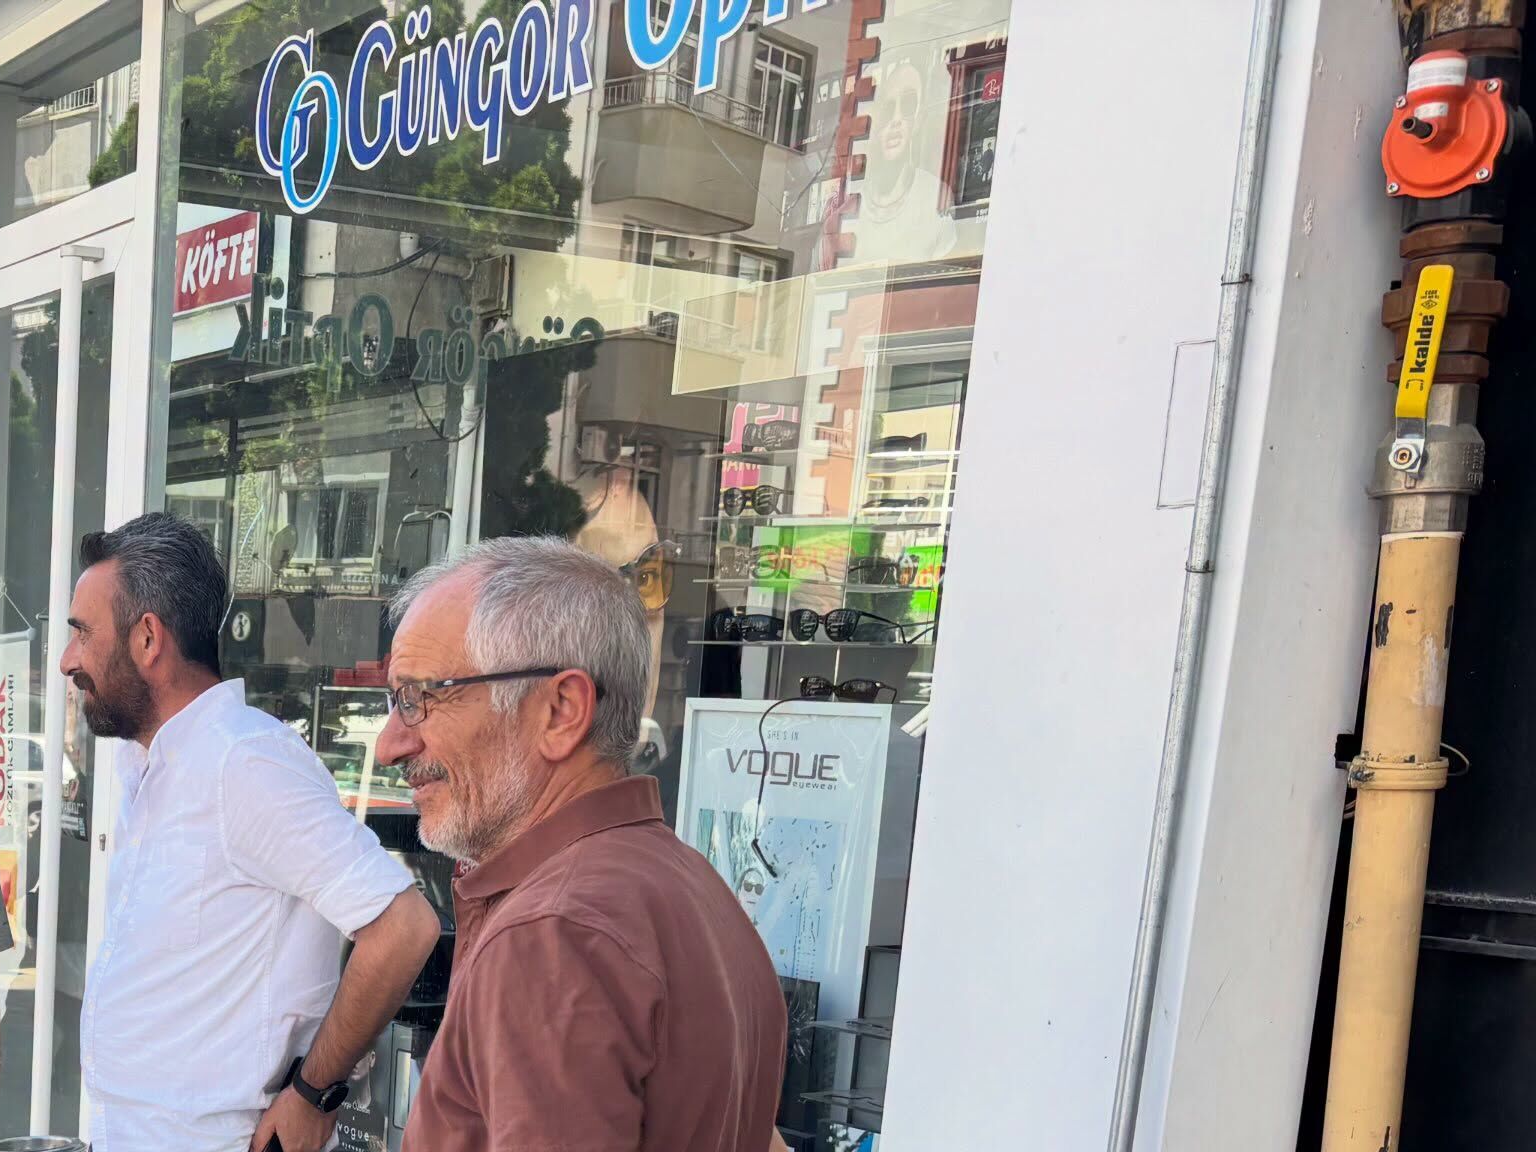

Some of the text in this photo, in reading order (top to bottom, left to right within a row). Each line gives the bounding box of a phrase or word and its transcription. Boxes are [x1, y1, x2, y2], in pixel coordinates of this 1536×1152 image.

[181, 229, 256, 295] KÖFTE
[1409, 314, 1435, 373] kalde
[791, 781, 838, 792] eyewear
[336, 1122, 370, 1142] vogue
